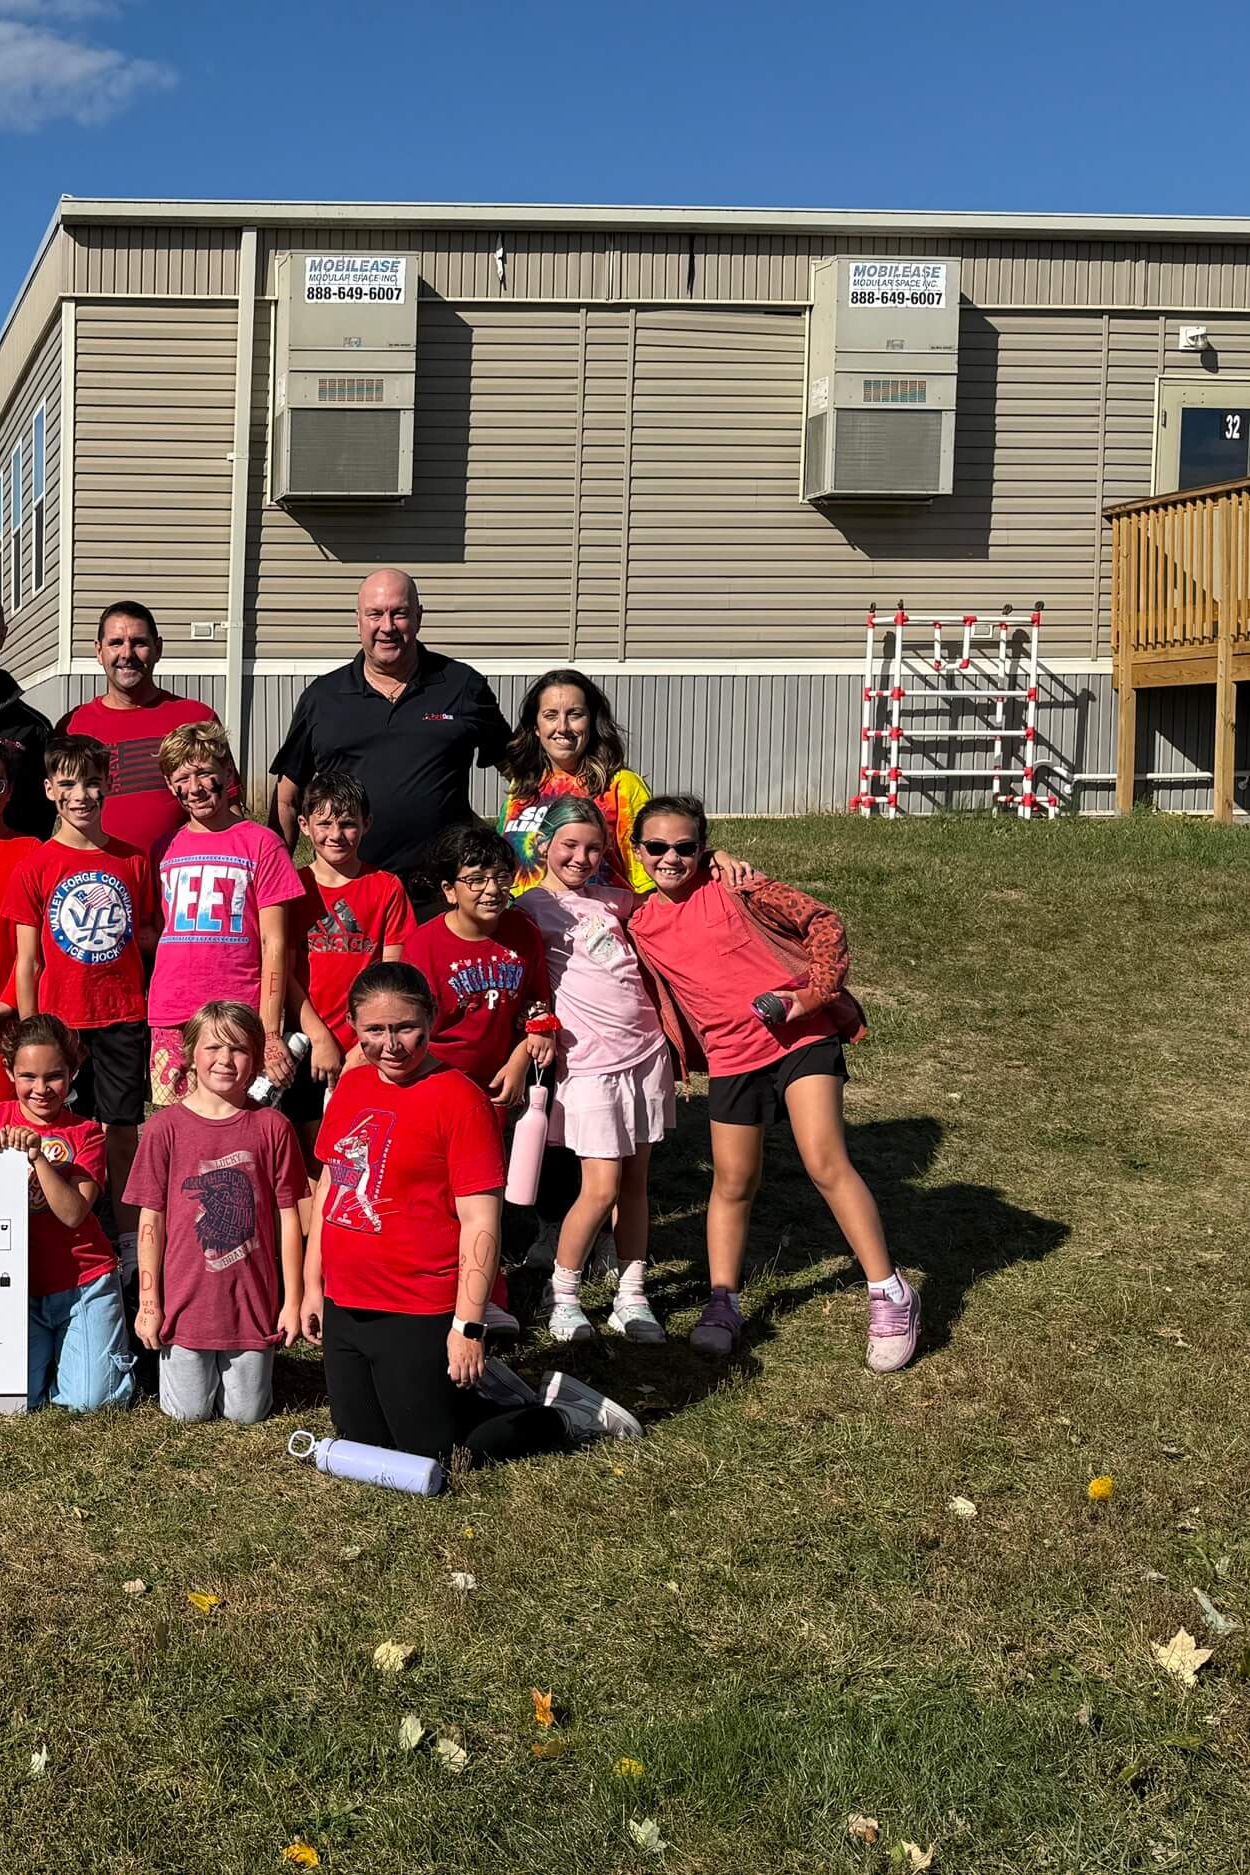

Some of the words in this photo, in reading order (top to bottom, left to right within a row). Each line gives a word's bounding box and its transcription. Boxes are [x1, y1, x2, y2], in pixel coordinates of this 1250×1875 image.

[309, 259, 401, 273] MOBILEASE
[853, 265, 942, 279] MOBILEASE
[308, 273, 350, 282] MODULAR
[352, 274, 380, 283] SPACE
[852, 279, 894, 287] MODULAR
[895, 279, 921, 288] SPACE
[306, 286, 403, 301] 888-649-6007
[850, 291, 943, 305] 888-649-6007
[1225, 414, 1241, 440] 32
[49, 891, 64, 932] VALLEY
[62, 872, 97, 892] FORGE
[66, 945, 85, 960] ICE
[91, 937, 126, 963] HOCKEY
[215, 1153, 241, 1169] LUCKY
